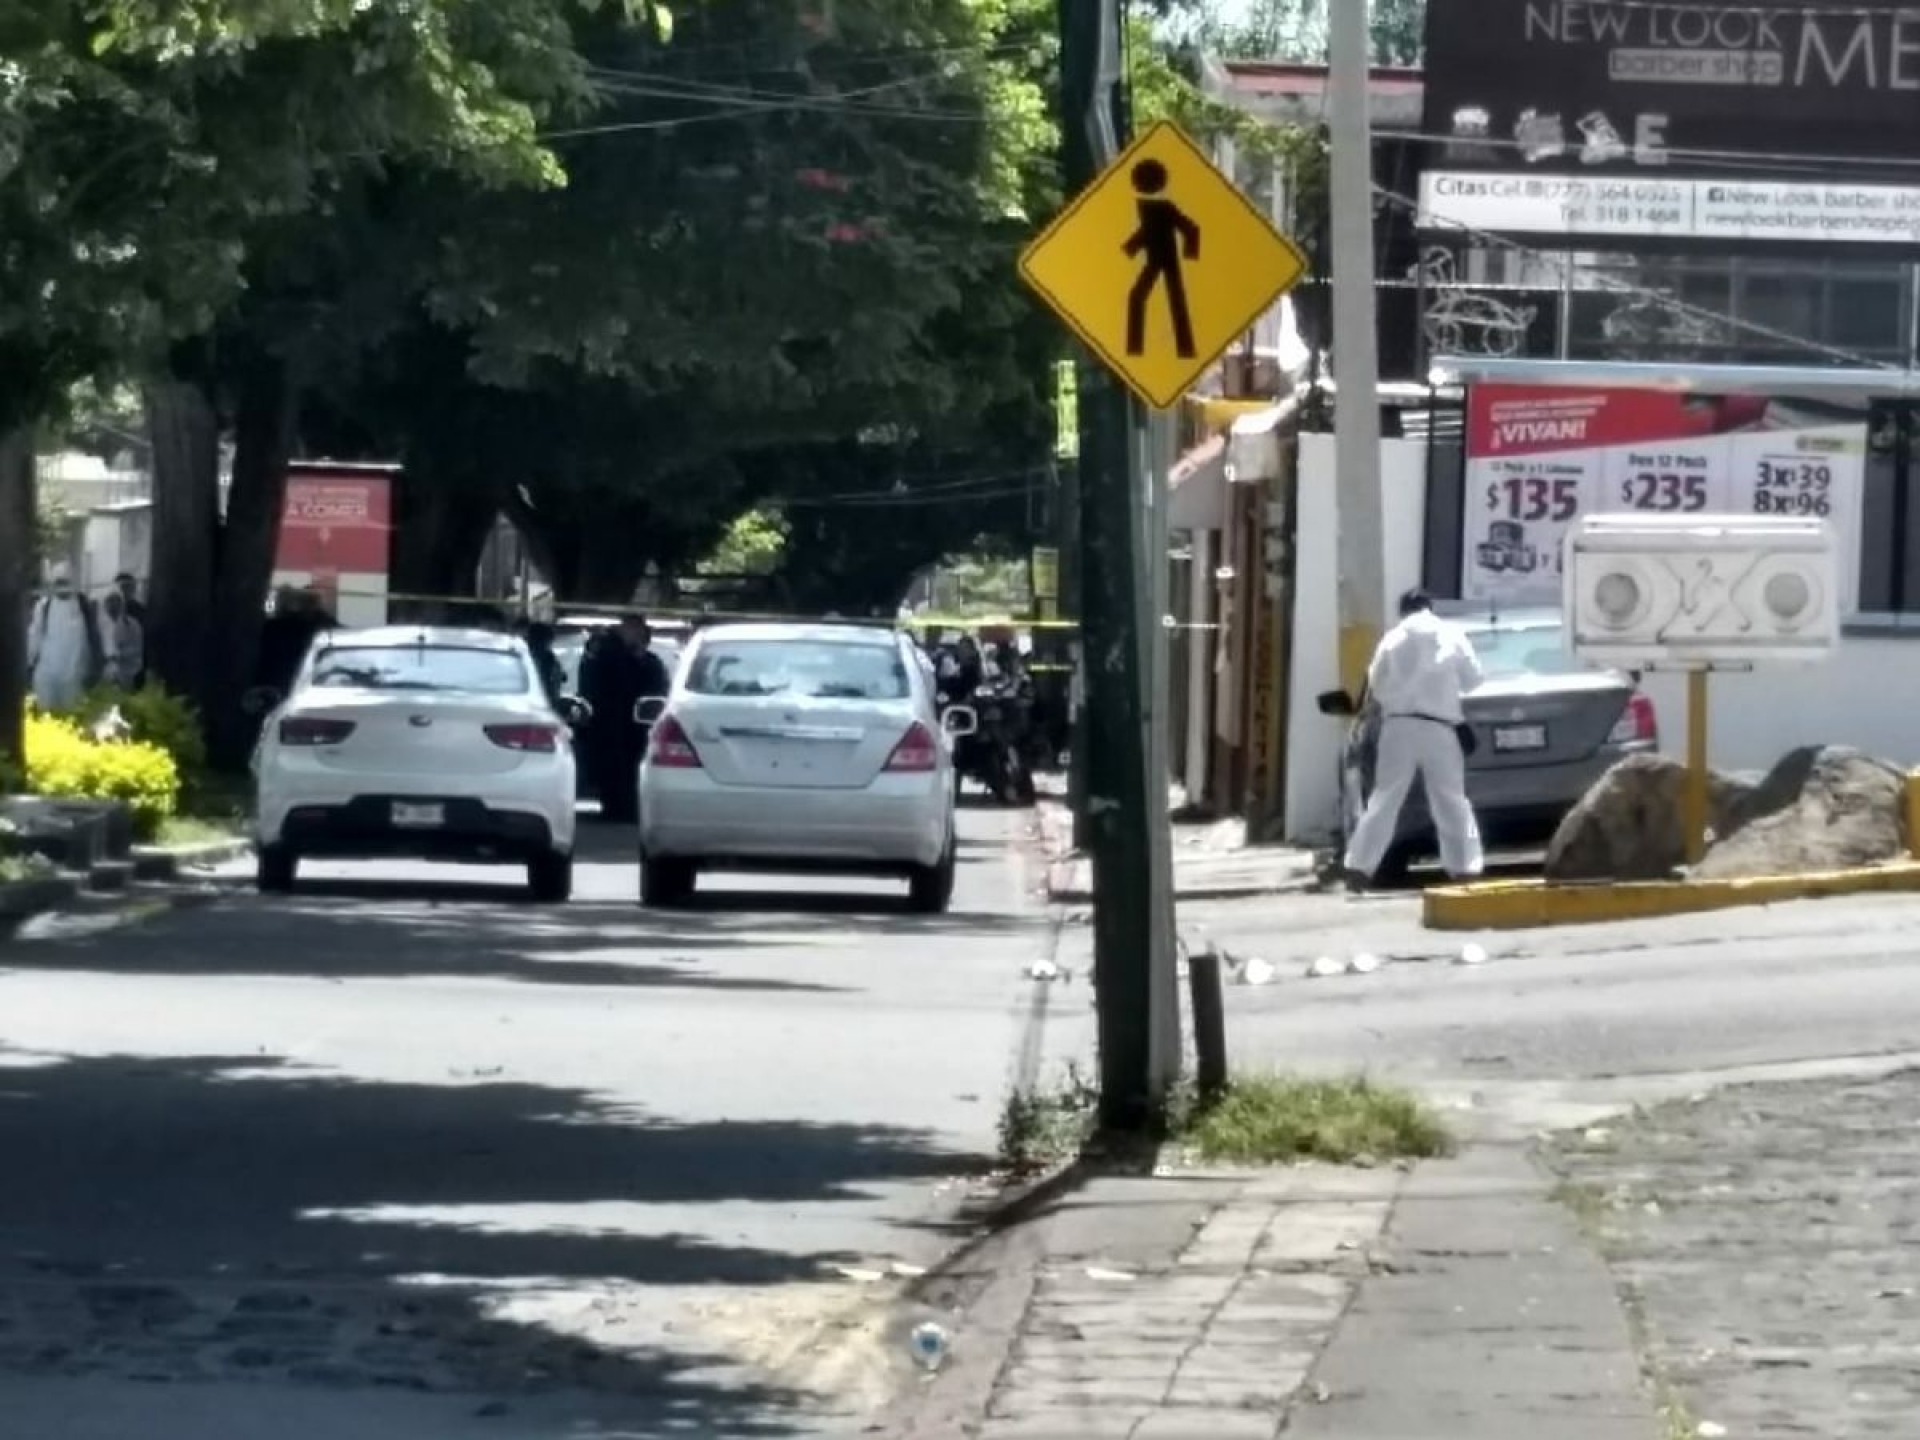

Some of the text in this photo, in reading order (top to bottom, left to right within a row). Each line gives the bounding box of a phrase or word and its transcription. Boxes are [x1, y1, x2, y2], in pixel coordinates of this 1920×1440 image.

[1525, 2, 1783, 48] NEW LOOK
[1612, 50, 1782, 82] barber shop
[1435, 177, 1487, 197] Citas
[1727, 190, 1769, 206] New
[1774, 190, 1819, 207] Look
[1490, 417, 1588, 450] ¡VIVAN!
[1486, 477, 1579, 523] $135
[1620, 472, 1708, 513] $235
